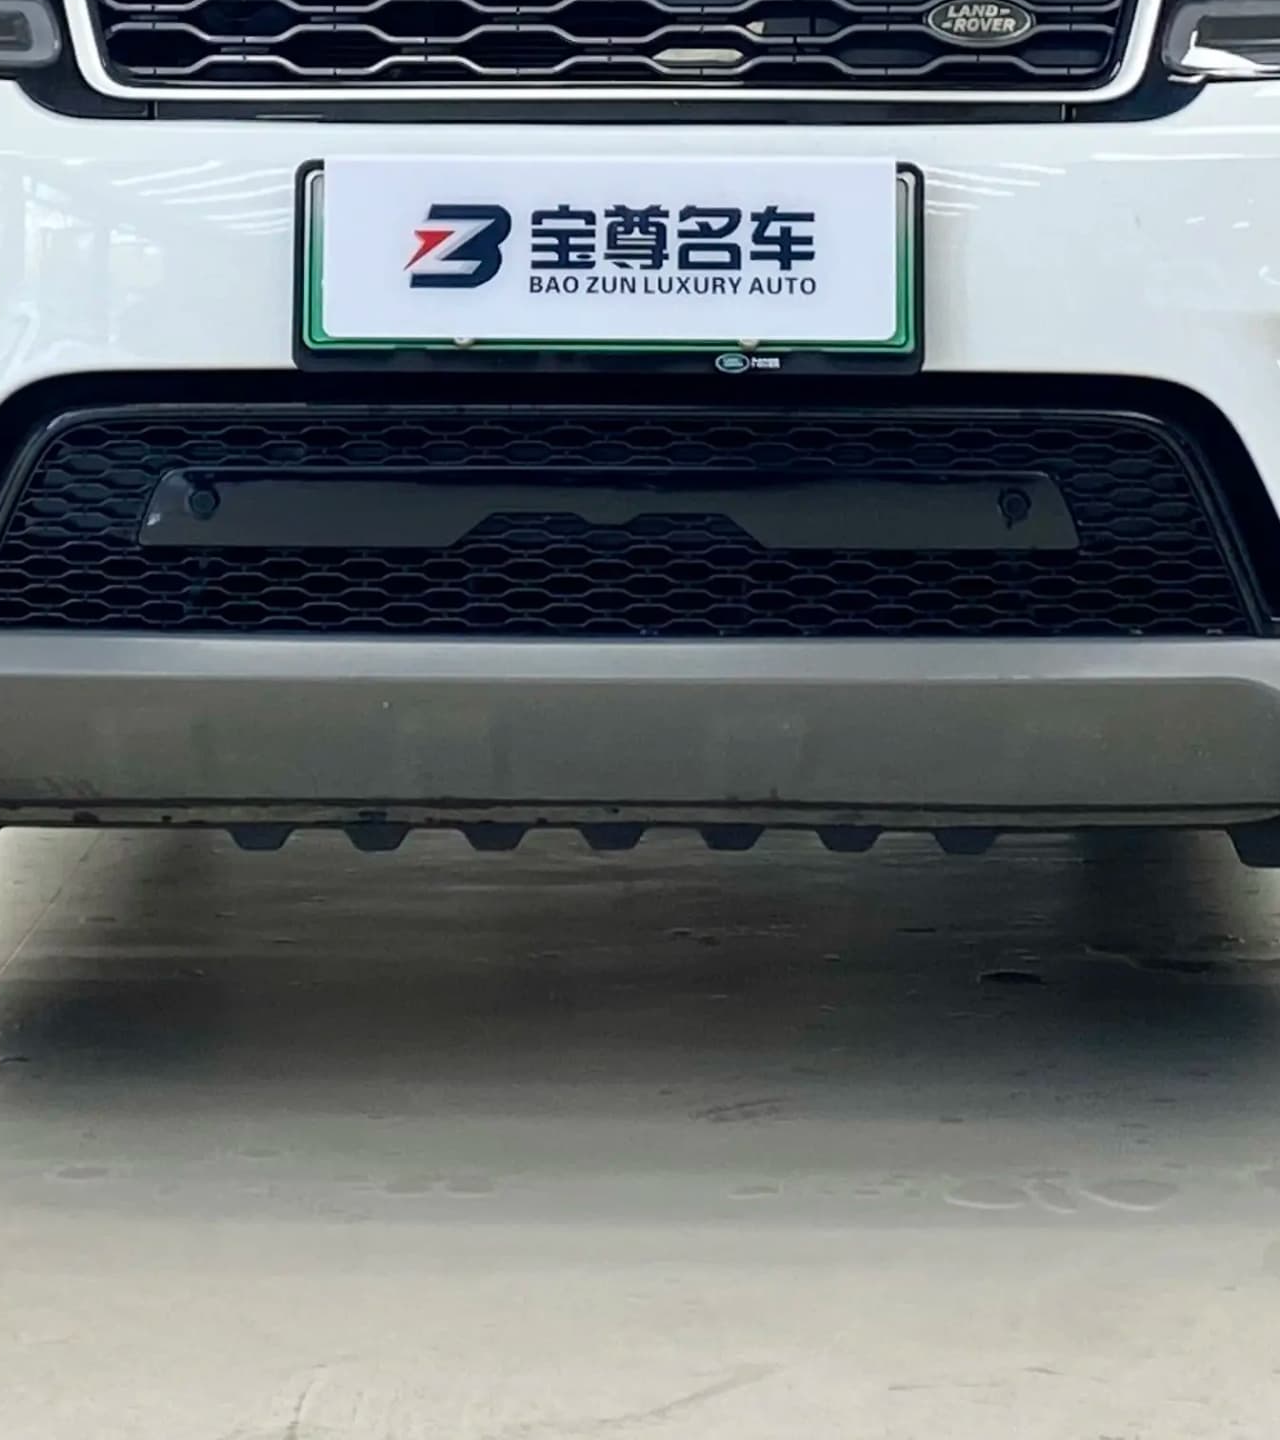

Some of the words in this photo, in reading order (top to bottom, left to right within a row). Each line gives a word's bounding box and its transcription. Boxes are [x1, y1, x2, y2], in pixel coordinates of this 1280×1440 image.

[531, 204, 815, 271] 宝尊名车
[529, 276, 579, 295] BAO
[586, 276, 636, 295] ZUN
[644, 276, 742, 295] LUXURY
[748, 276, 817, 295] AUTO
